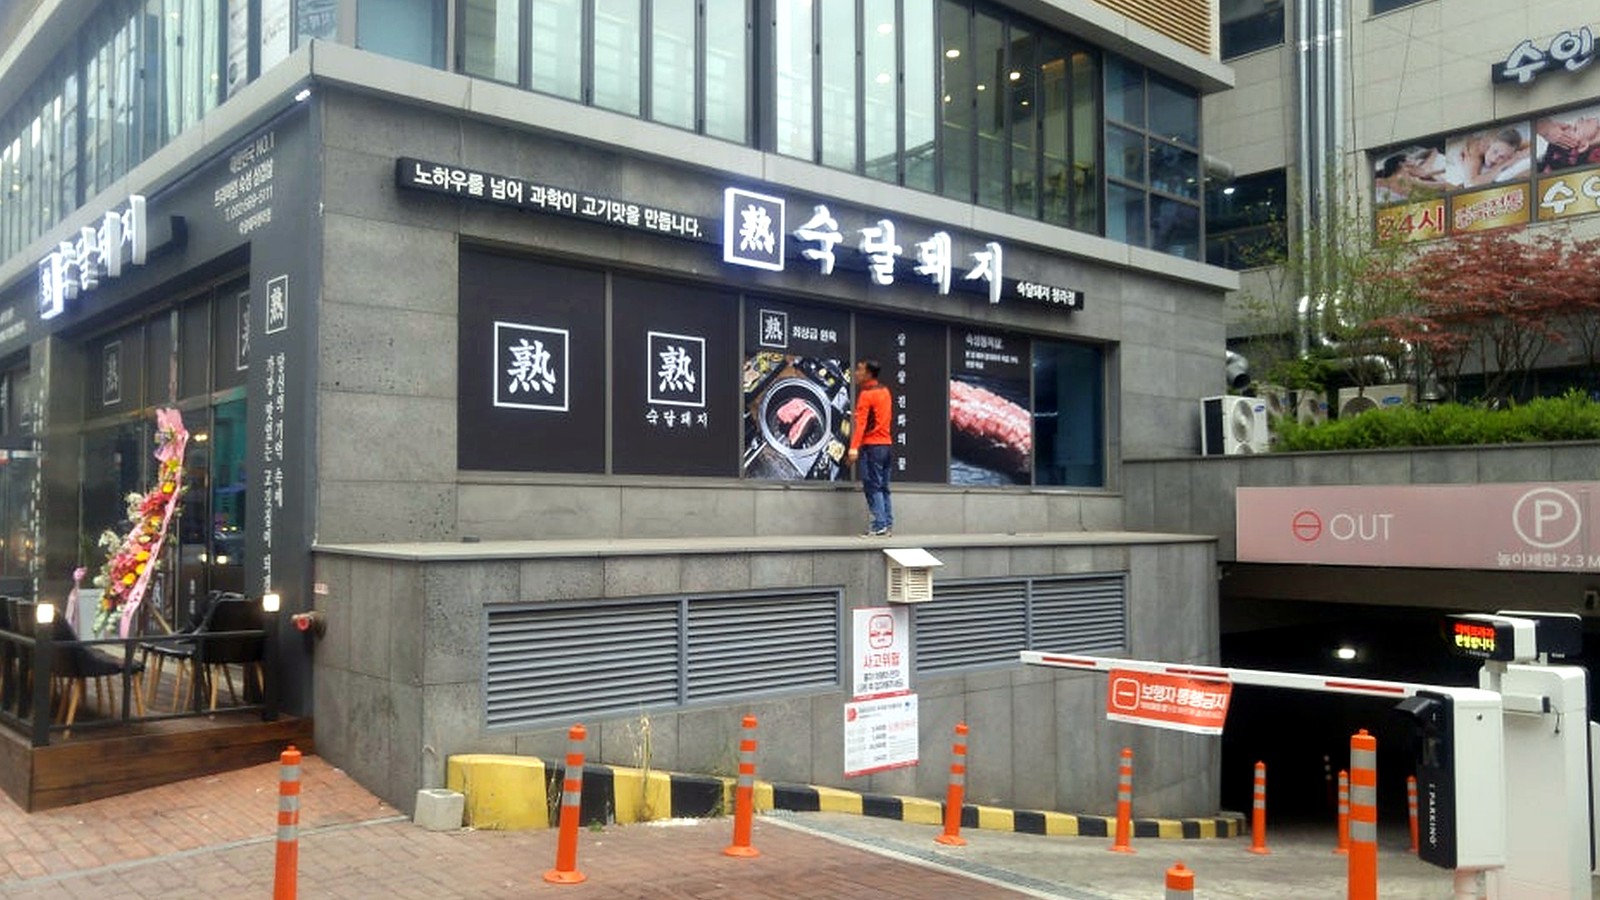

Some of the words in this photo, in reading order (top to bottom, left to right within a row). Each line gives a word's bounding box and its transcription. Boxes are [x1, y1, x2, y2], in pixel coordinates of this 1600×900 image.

[413, 163, 485, 197] 노하우를
[490, 176, 523, 203] 넘어
[530, 186, 577, 214] 과학이
[581, 196, 640, 227] 고기맛을
[644, 208, 703, 238] 만듭니다.
[794, 204, 1003, 304] 숙달돼지
[1017, 281, 1050, 302] 숙달돼지
[507, 338, 557, 394] 熟
[658, 345, 696, 393] 熟
[645, 409, 709, 428] 숙달돼지
[1329, 513, 1394, 541] OUT
[1534, 499, 1563, 538] P
[1498, 551, 1557, 568] 높이제한
[1561, 553, 1585, 568] 2.3
[863, 651, 901, 669] 사고위험
[1141, 683, 1177, 703] 보행자
[1177, 688, 1228, 710] 통행금지
